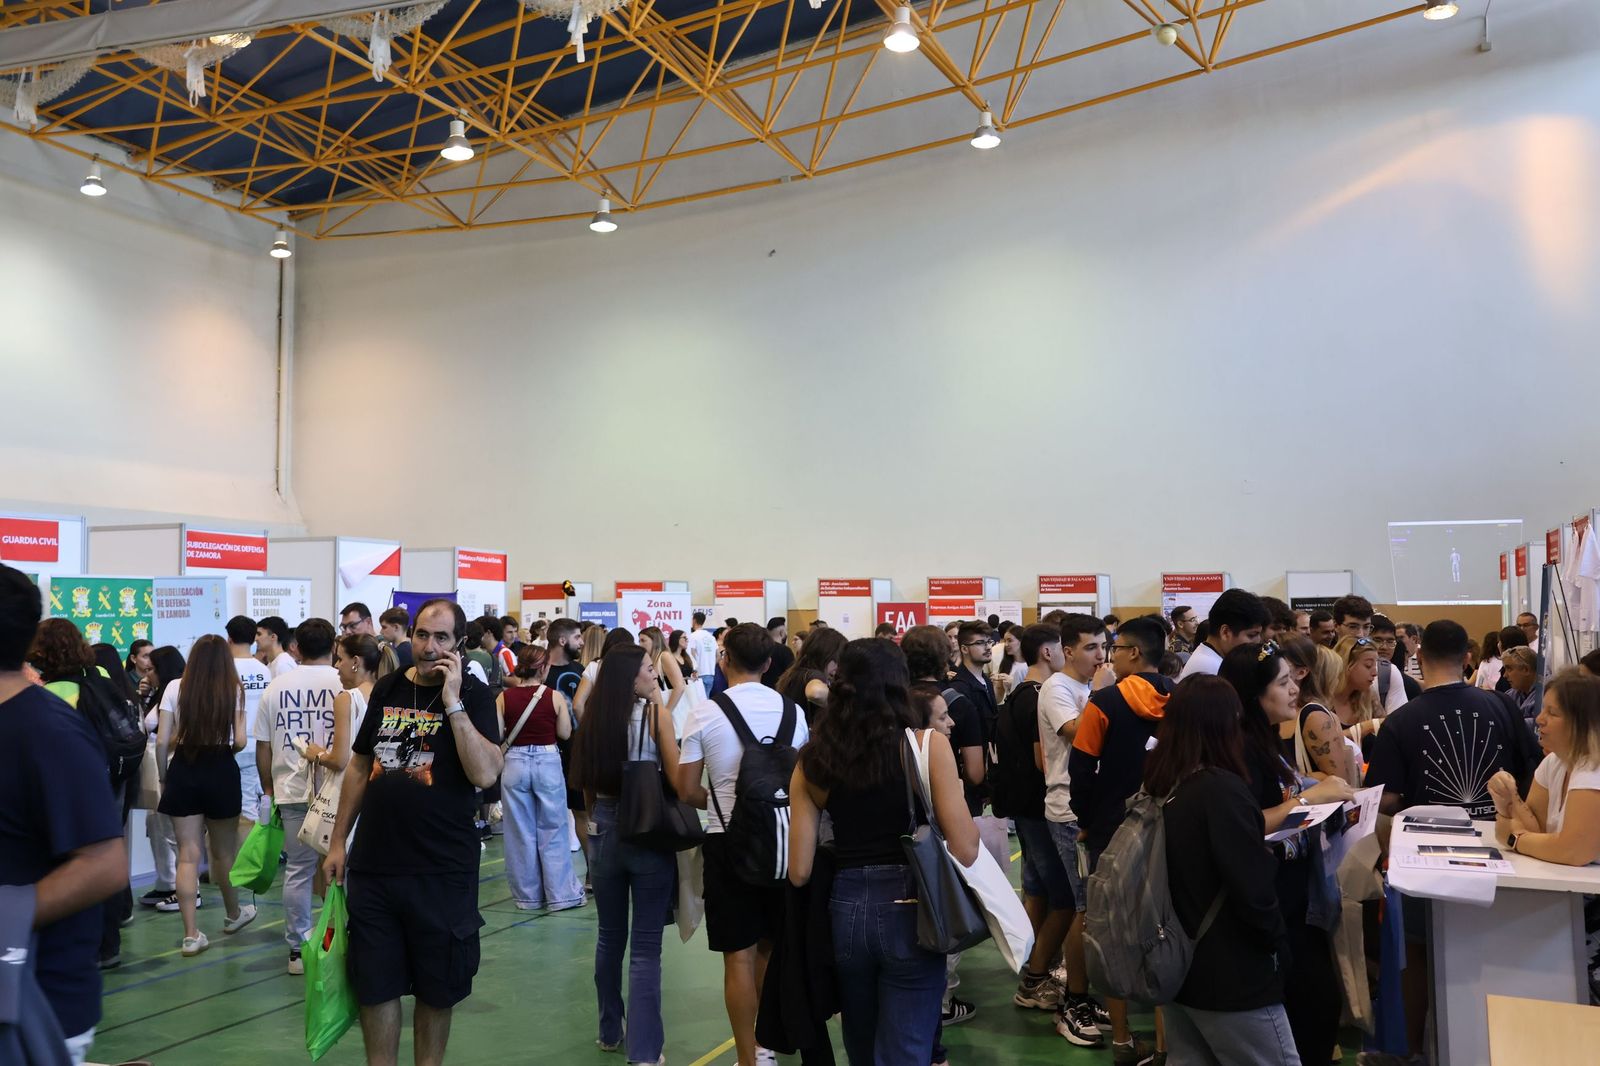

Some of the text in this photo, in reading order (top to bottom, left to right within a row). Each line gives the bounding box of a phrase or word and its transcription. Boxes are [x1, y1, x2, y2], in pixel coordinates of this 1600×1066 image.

[2, 535, 58, 546] GUARDIA CIVIL
[187, 541, 233, 551] SUBDELEGACIÓN
[196, 551, 222, 559] ZAMORA
[156, 586, 203, 596] SUBDELEGACIÓN
[157, 598, 190, 608] DE DEFENSA
[157, 610, 164, 618] EN
[166, 610, 190, 618] ZAMORA
[655, 611, 682, 620] ANTI
[280, 689, 300, 709] IN
[1464, 806, 1496, 816] OUTSID
